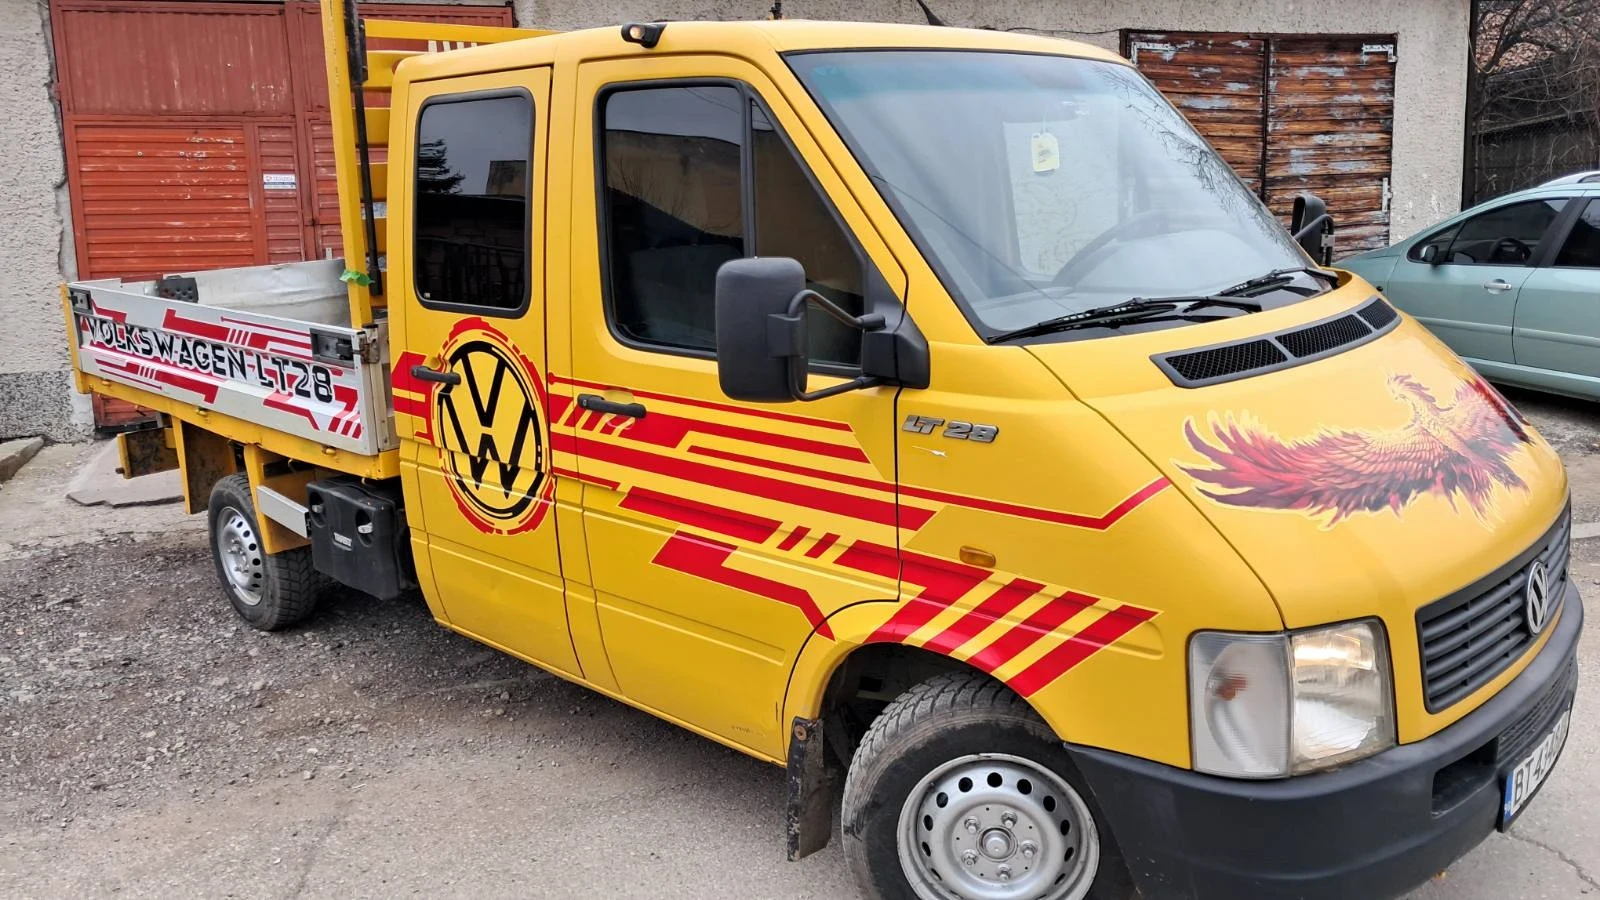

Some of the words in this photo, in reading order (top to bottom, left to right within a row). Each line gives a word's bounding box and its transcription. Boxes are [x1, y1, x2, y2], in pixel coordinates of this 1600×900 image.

[87, 317, 247, 379] VOLKSWAGEN
[902, 414, 945, 435] LT
[943, 420, 999, 443] 28
